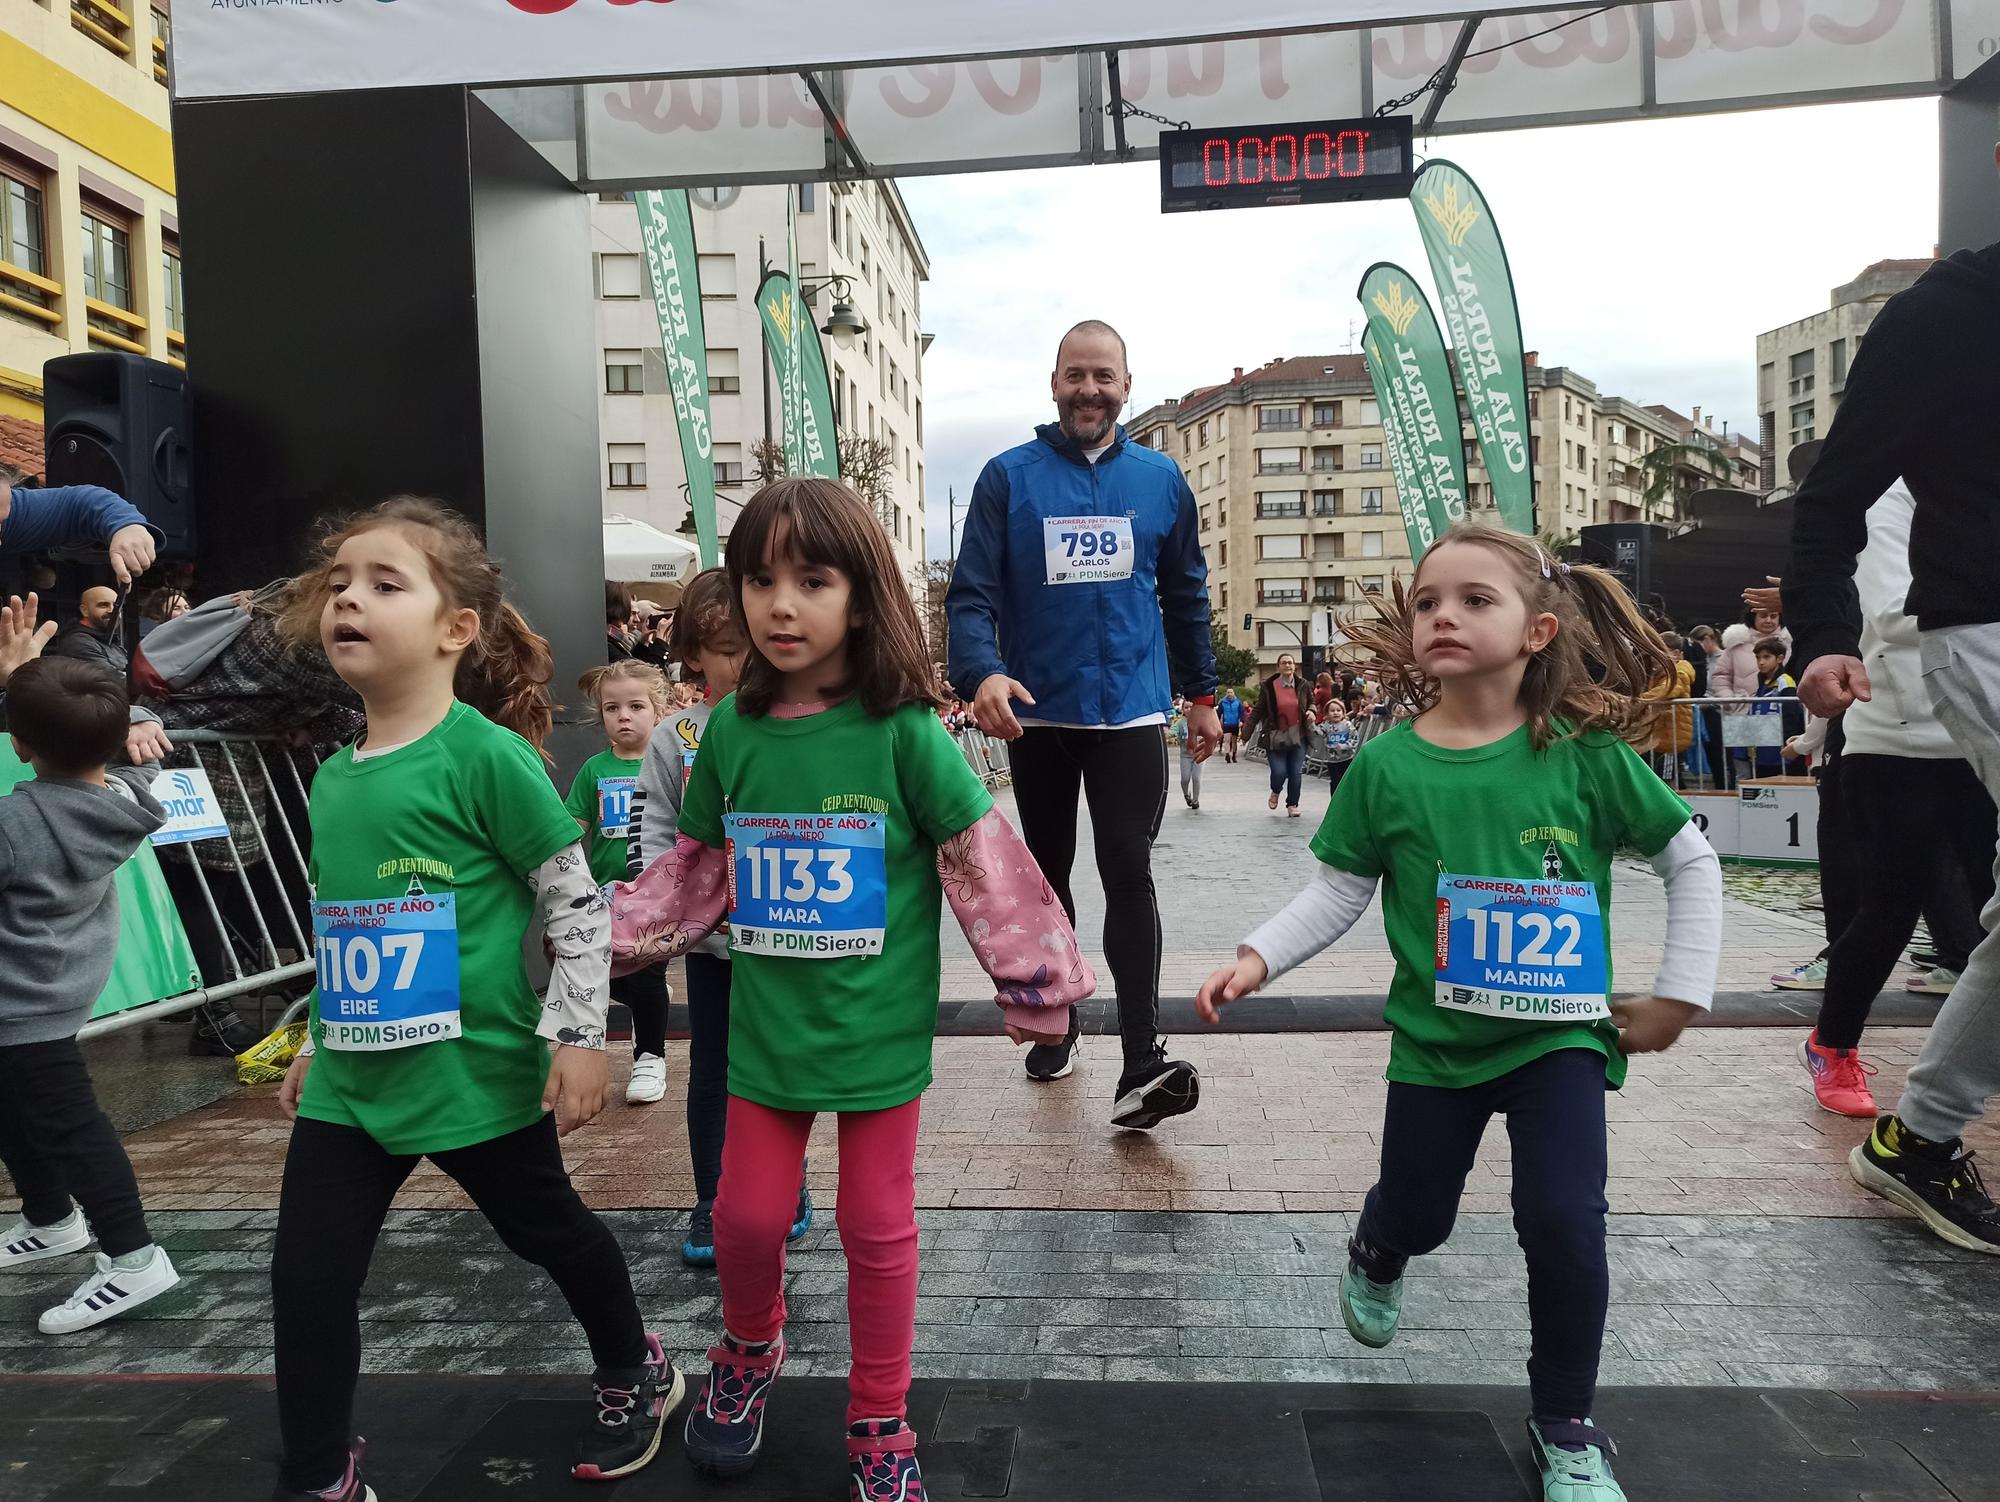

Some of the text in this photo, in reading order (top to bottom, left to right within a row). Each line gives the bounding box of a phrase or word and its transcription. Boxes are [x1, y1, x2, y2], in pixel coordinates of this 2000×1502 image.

[1061, 531, 1118, 557] 798
[1071, 558, 1110, 567] CARLOS
[1079, 570, 1125, 579] PDMSiero
[822, 795, 842, 814] CEIP
[736, 815, 867, 830] CARRERA FIN DE AÑO
[1786, 811, 1800, 847] 1
[799, 831, 825, 841] SIERO
[1519, 827, 1537, 846] CEIP
[377, 857, 455, 880] CEIP XENTIQUINA
[746, 847, 854, 904] 1133
[1453, 879, 1586, 898] CARRERA FIN DE AÑO
[353, 904, 373, 917] FIN
[376, 902, 396, 915] DE
[400, 898, 435, 913] AÑO
[1494, 895, 1560, 907] LA POLA SIERO
[359, 917, 386, 929] SIERO
[768, 906, 823, 924] MARA
[773, 933, 867, 952] PDMSiero
[1466, 908, 1582, 967] 1122
[319, 931, 425, 994] 1107
[1485, 967, 1566, 988] MARINA
[340, 999, 379, 1015] EIRE
[1500, 994, 1593, 1015] PDMSiero
[340, 1022, 440, 1044] PDMSiero
